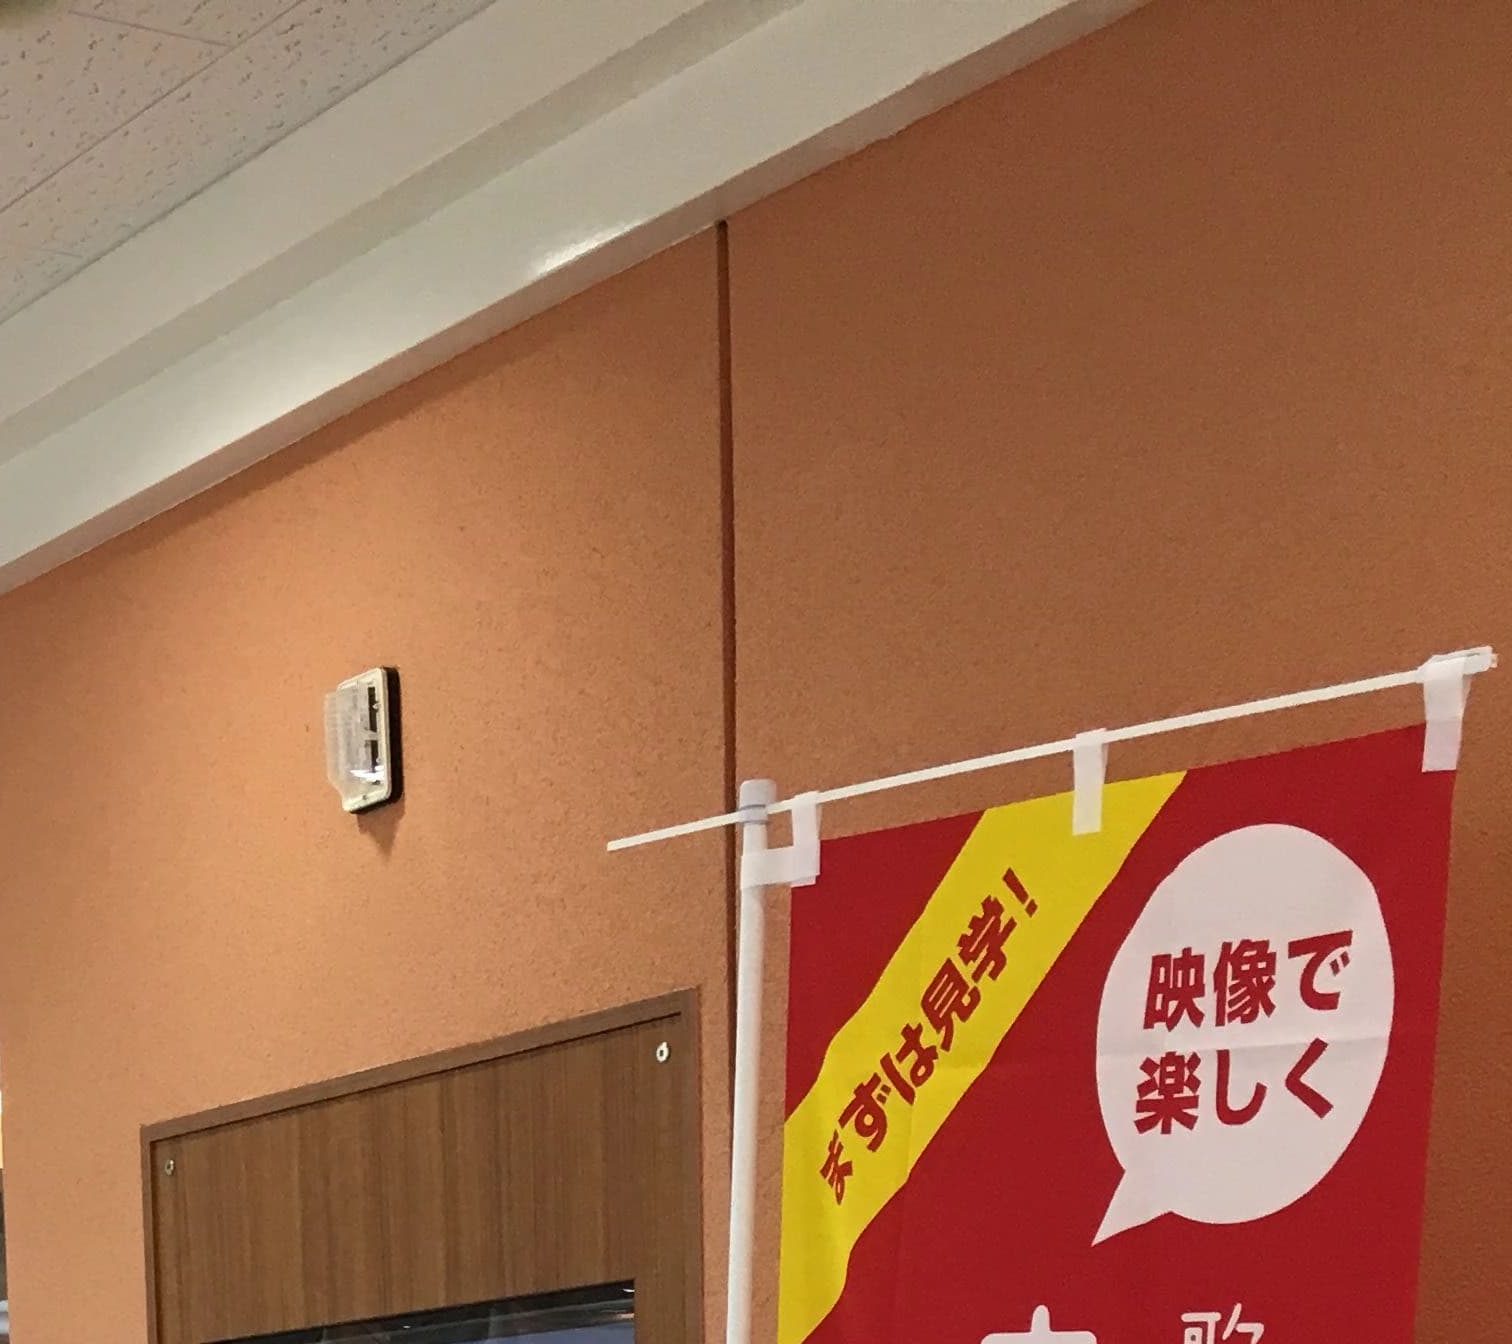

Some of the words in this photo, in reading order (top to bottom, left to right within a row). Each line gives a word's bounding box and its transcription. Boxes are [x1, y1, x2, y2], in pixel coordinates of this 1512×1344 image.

[1143, 929, 1353, 1032] 映像で
[1134, 1038, 1334, 1135] 楽しく
